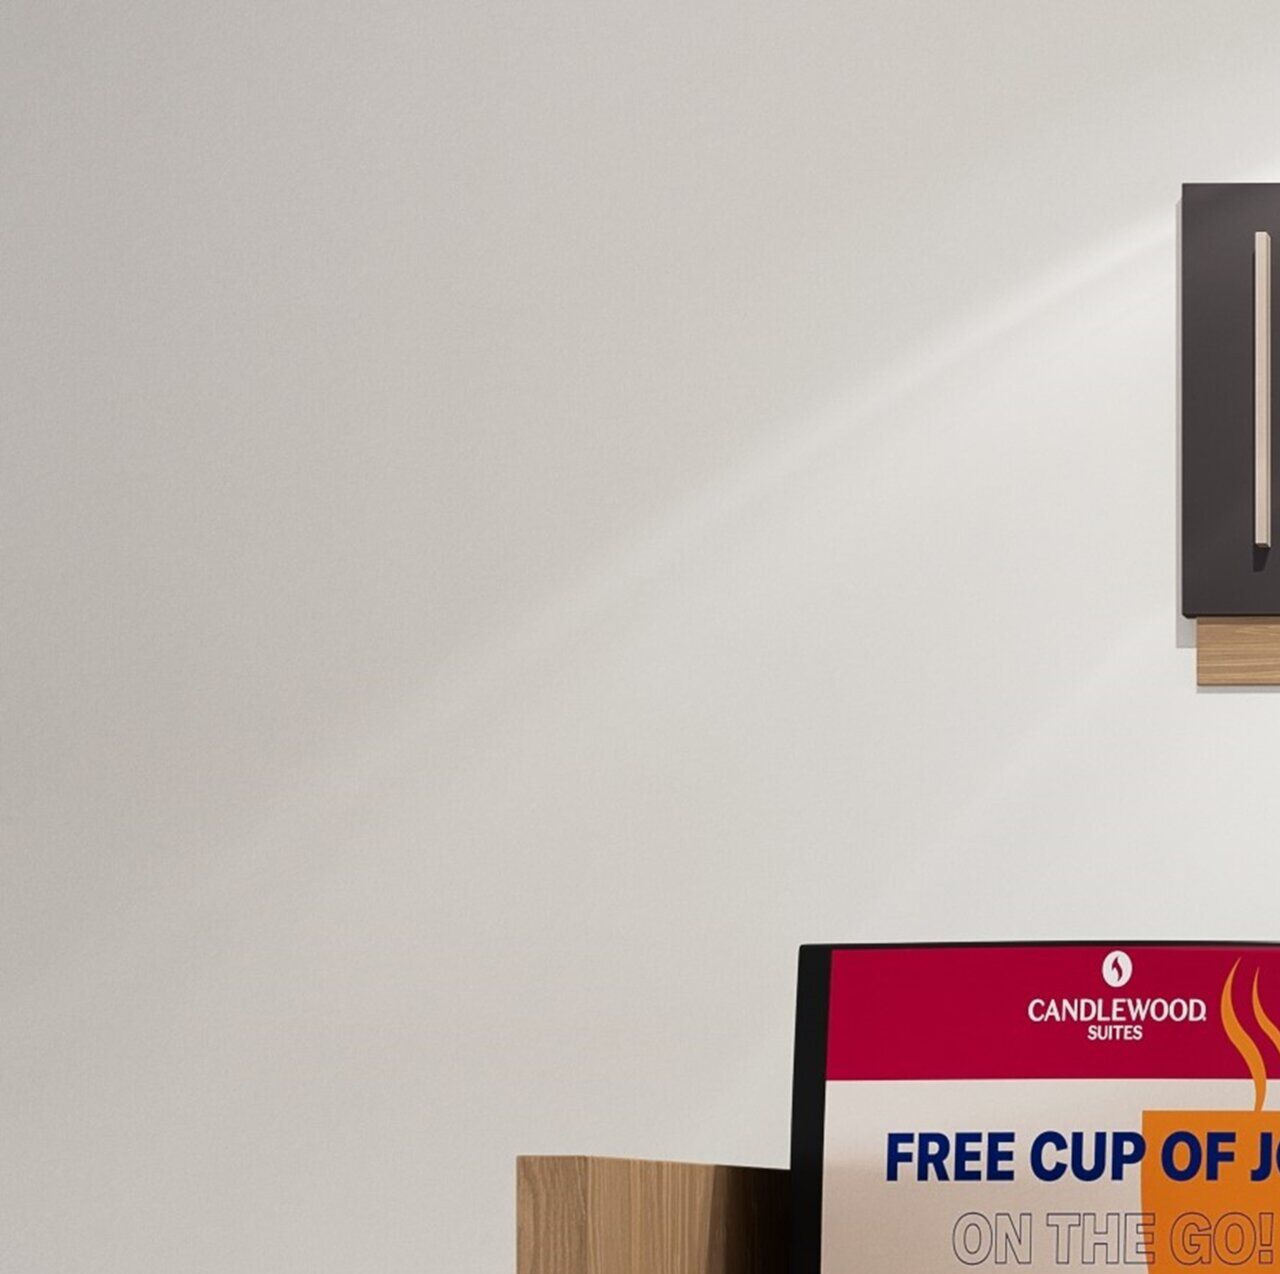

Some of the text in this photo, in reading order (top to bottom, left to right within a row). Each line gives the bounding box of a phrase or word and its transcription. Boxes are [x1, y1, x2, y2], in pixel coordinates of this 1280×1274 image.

[1028, 998, 1207, 1022] CANDLEWOOD
[1087, 1025, 1143, 1040] SUITES
[886, 1131, 1015, 1182] FREE
[1029, 1131, 1146, 1182] CUP
[1160, 1131, 1236, 1182] OF
[952, 1212, 1274, 1265] ON THE GO!
